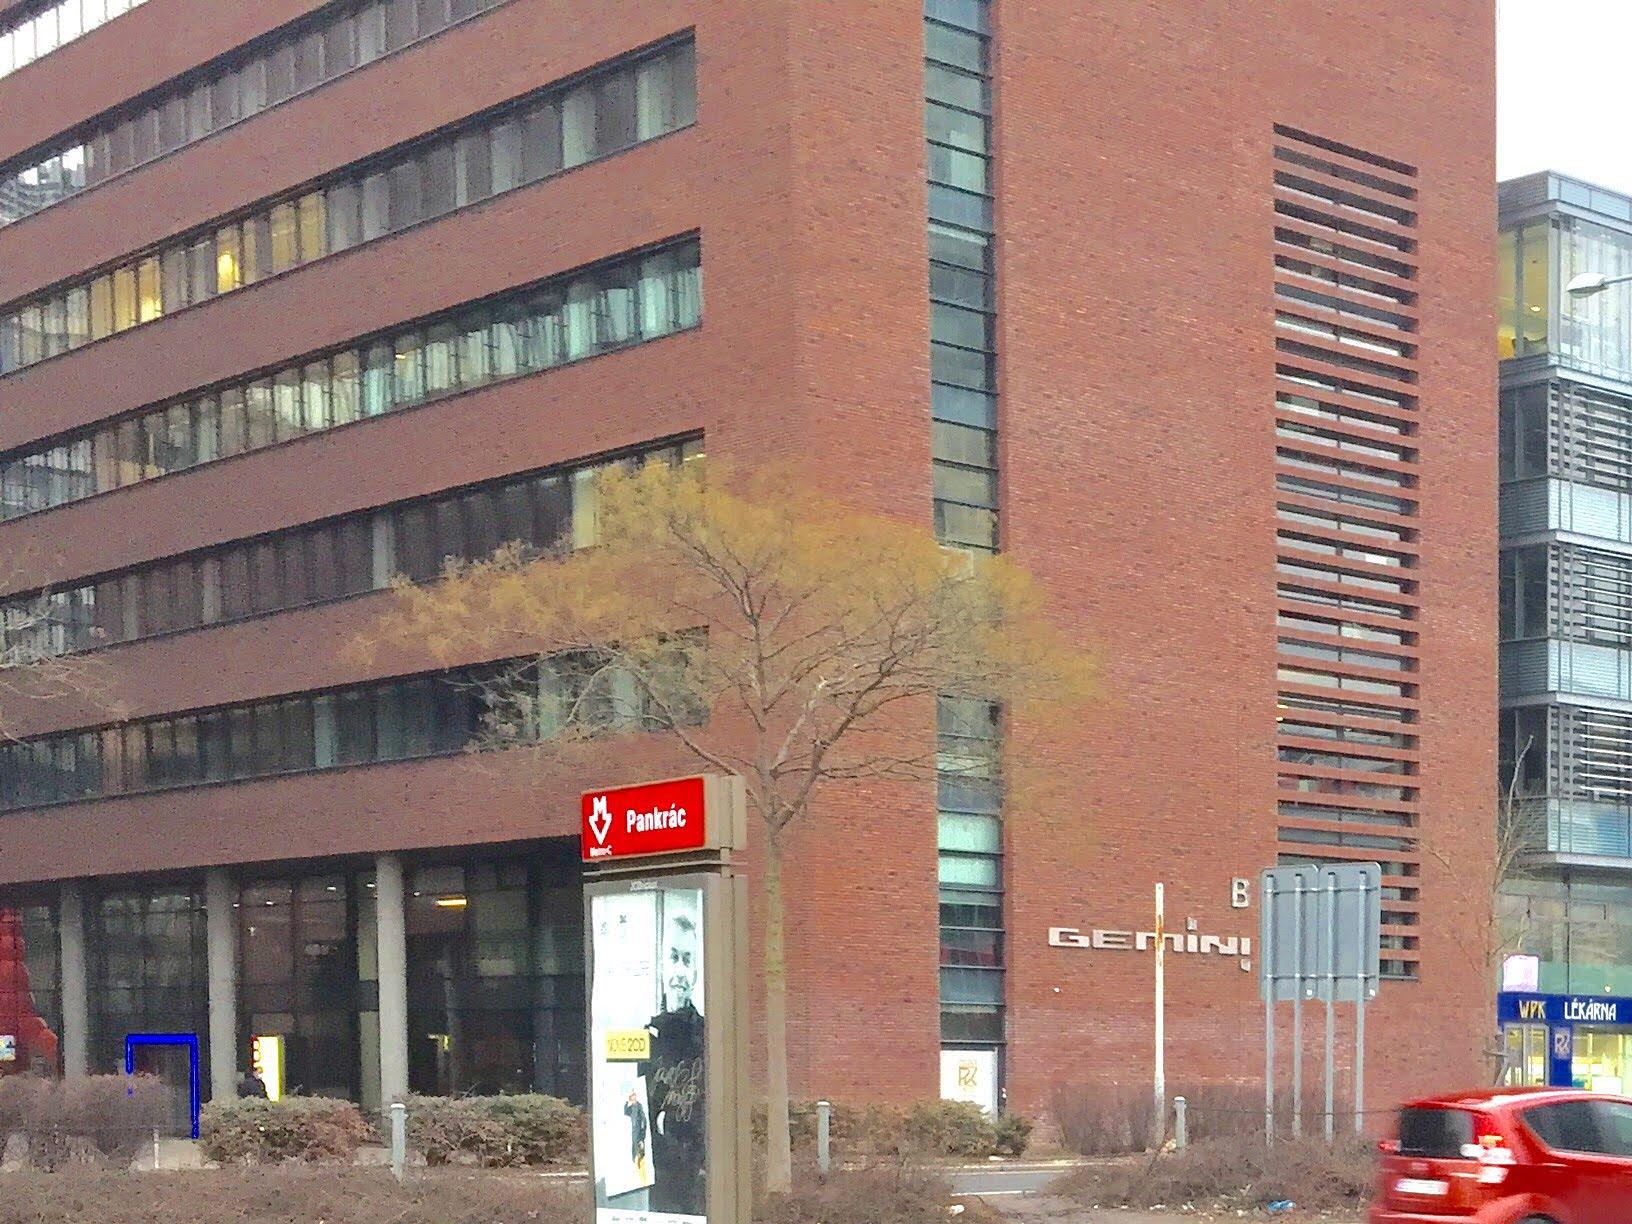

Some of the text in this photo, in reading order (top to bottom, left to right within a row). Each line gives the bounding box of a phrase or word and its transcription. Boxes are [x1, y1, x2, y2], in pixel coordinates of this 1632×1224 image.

[626, 803, 687, 833] Pankrác
[1231, 877, 1250, 908] B
[1519, 997, 1617, 1021] WPK LÉKÁRNA
